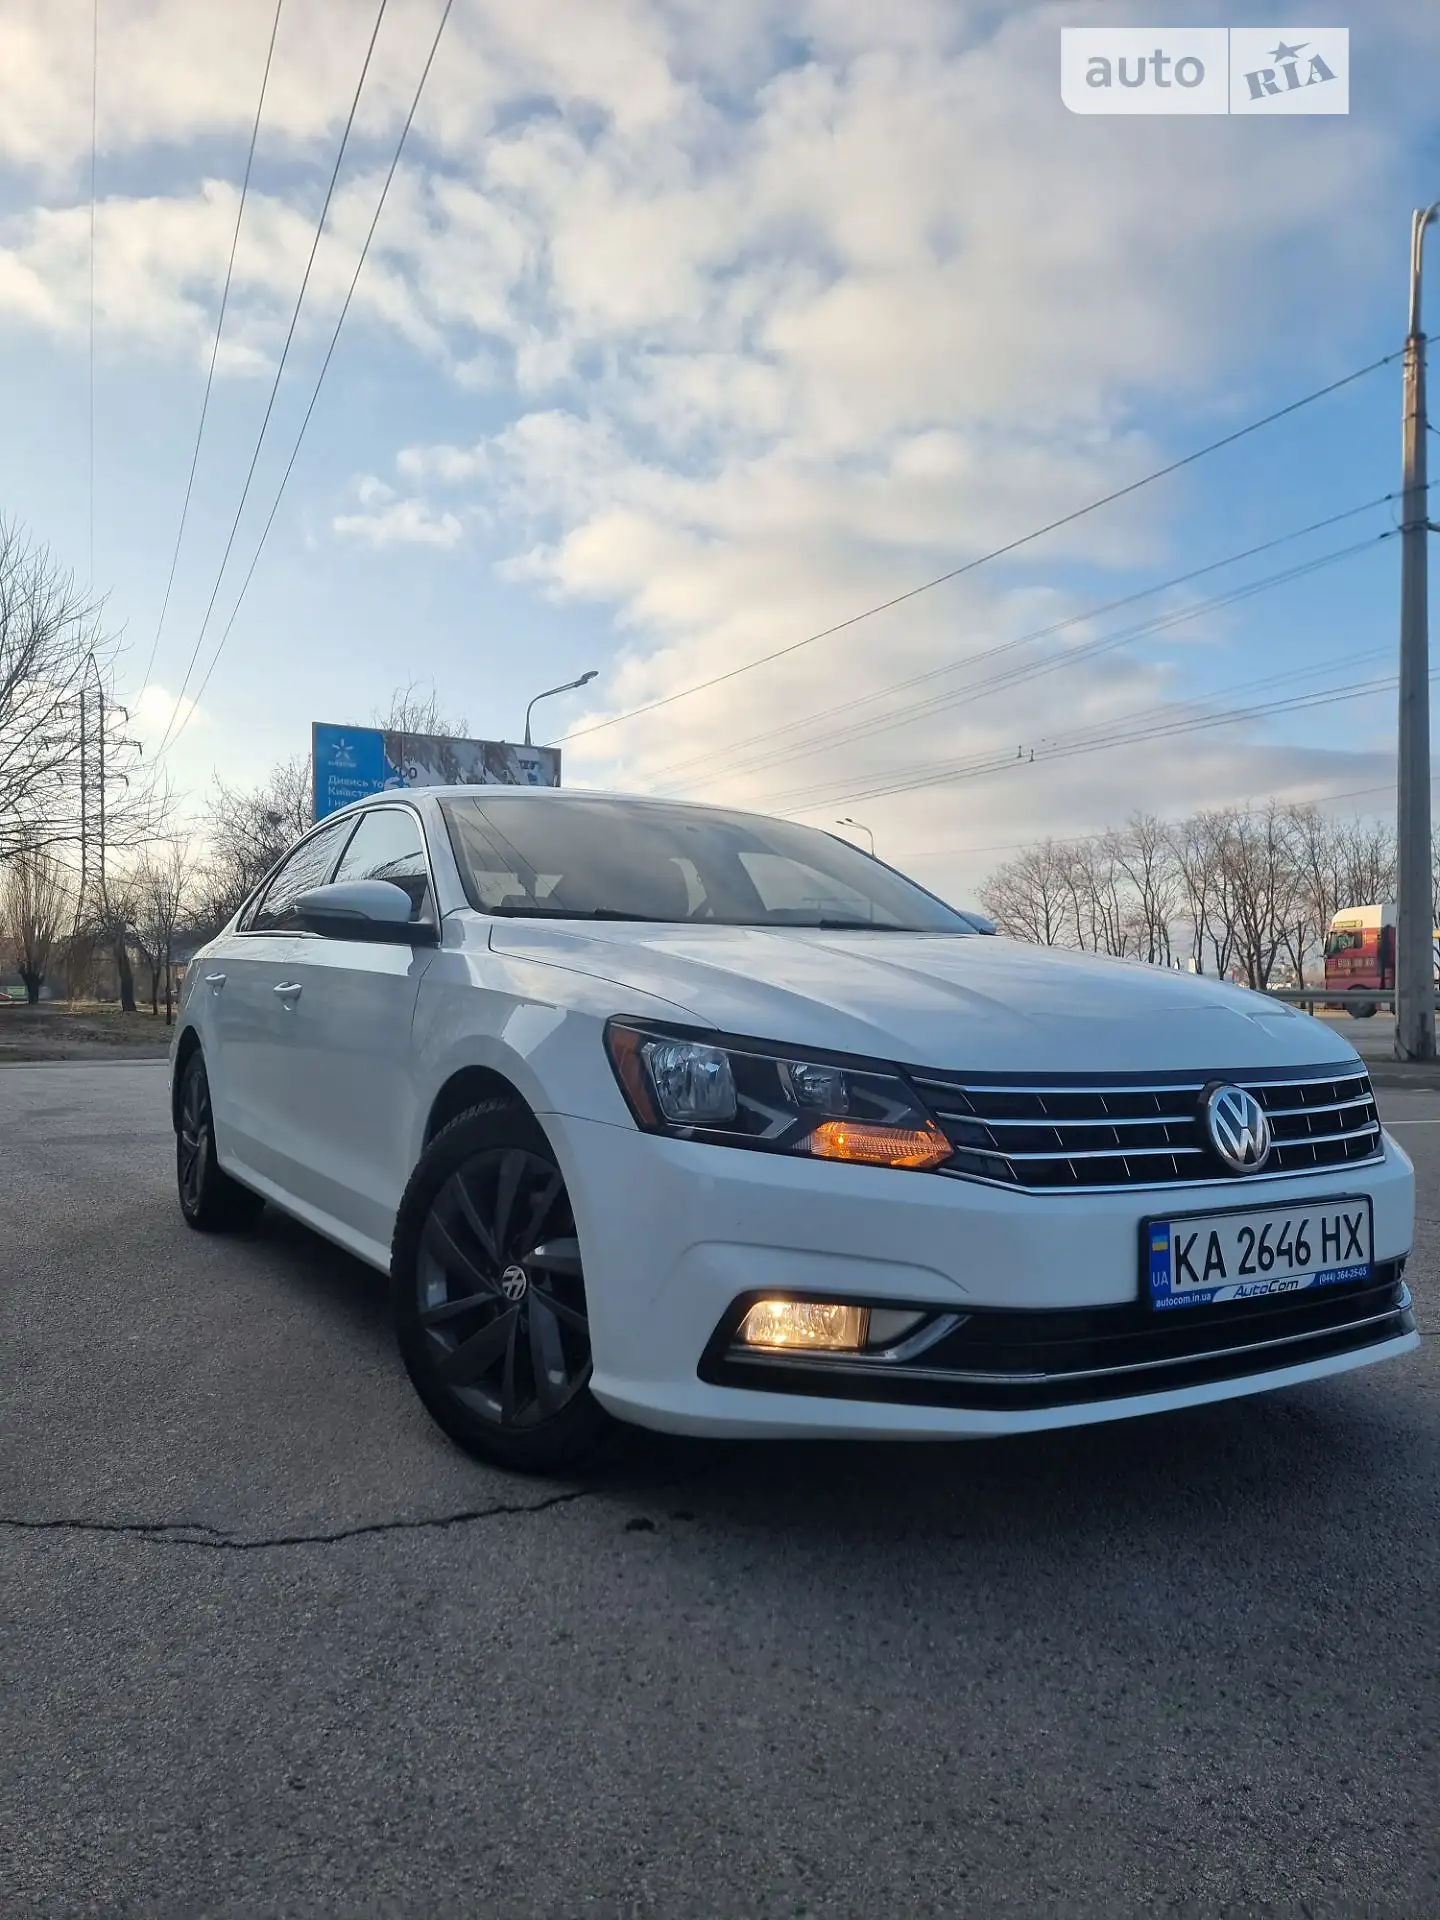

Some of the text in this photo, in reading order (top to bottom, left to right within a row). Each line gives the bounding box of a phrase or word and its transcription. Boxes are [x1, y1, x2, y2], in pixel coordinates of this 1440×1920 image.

[328, 775, 369, 788] Дивись
[1174, 1212, 1364, 1285] KA 2646 HX
[1152, 1272, 1169, 1287] UA
[1232, 1279, 1299, 1298] AutoCom
[1156, 1292, 1212, 1308] autocom.in.ua
